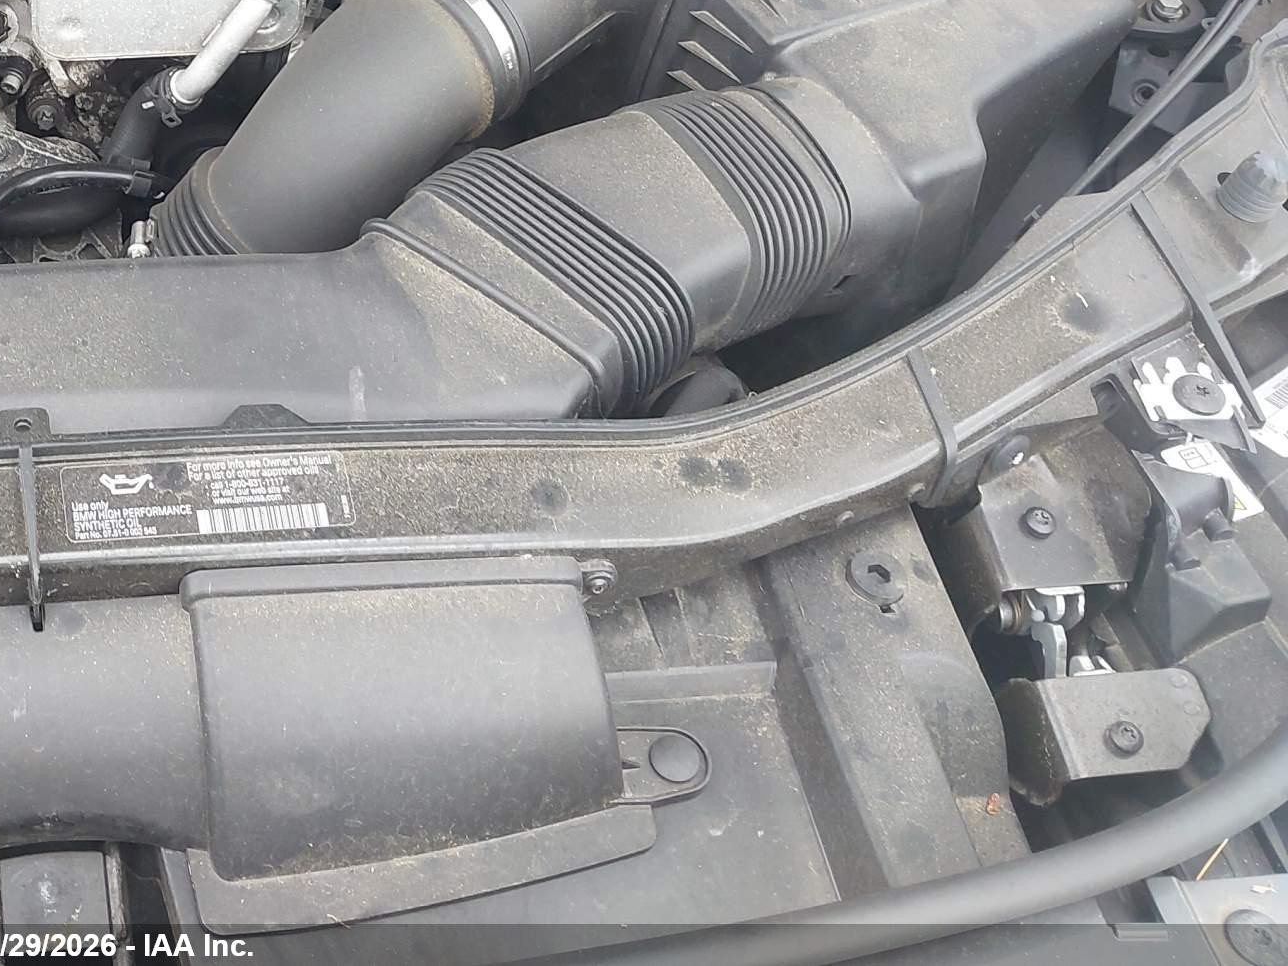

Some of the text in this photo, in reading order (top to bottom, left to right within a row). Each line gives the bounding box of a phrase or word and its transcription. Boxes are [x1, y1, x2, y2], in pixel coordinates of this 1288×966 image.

[186, 462, 201, 472] For
[202, 461, 227, 471] more
[245, 459, 261, 468] see
[262, 455, 299, 467] Owner's
[299, 454, 332, 465] Manual
[187, 471, 202, 481] For
[225, 469, 236, 479] of
[236, 468, 261, 478] other
[261, 465, 304, 477] approved
[210, 481, 224, 489] call
[282, 485, 290, 493] at
[71, 499, 109, 513] Use only
[72, 504, 192, 521] BMW HIGH PERFORMANCE
[73, 517, 142, 532] SYNTHETIC OIL
[75, 531, 89, 540] Part
[90, 530, 102, 539] No.
